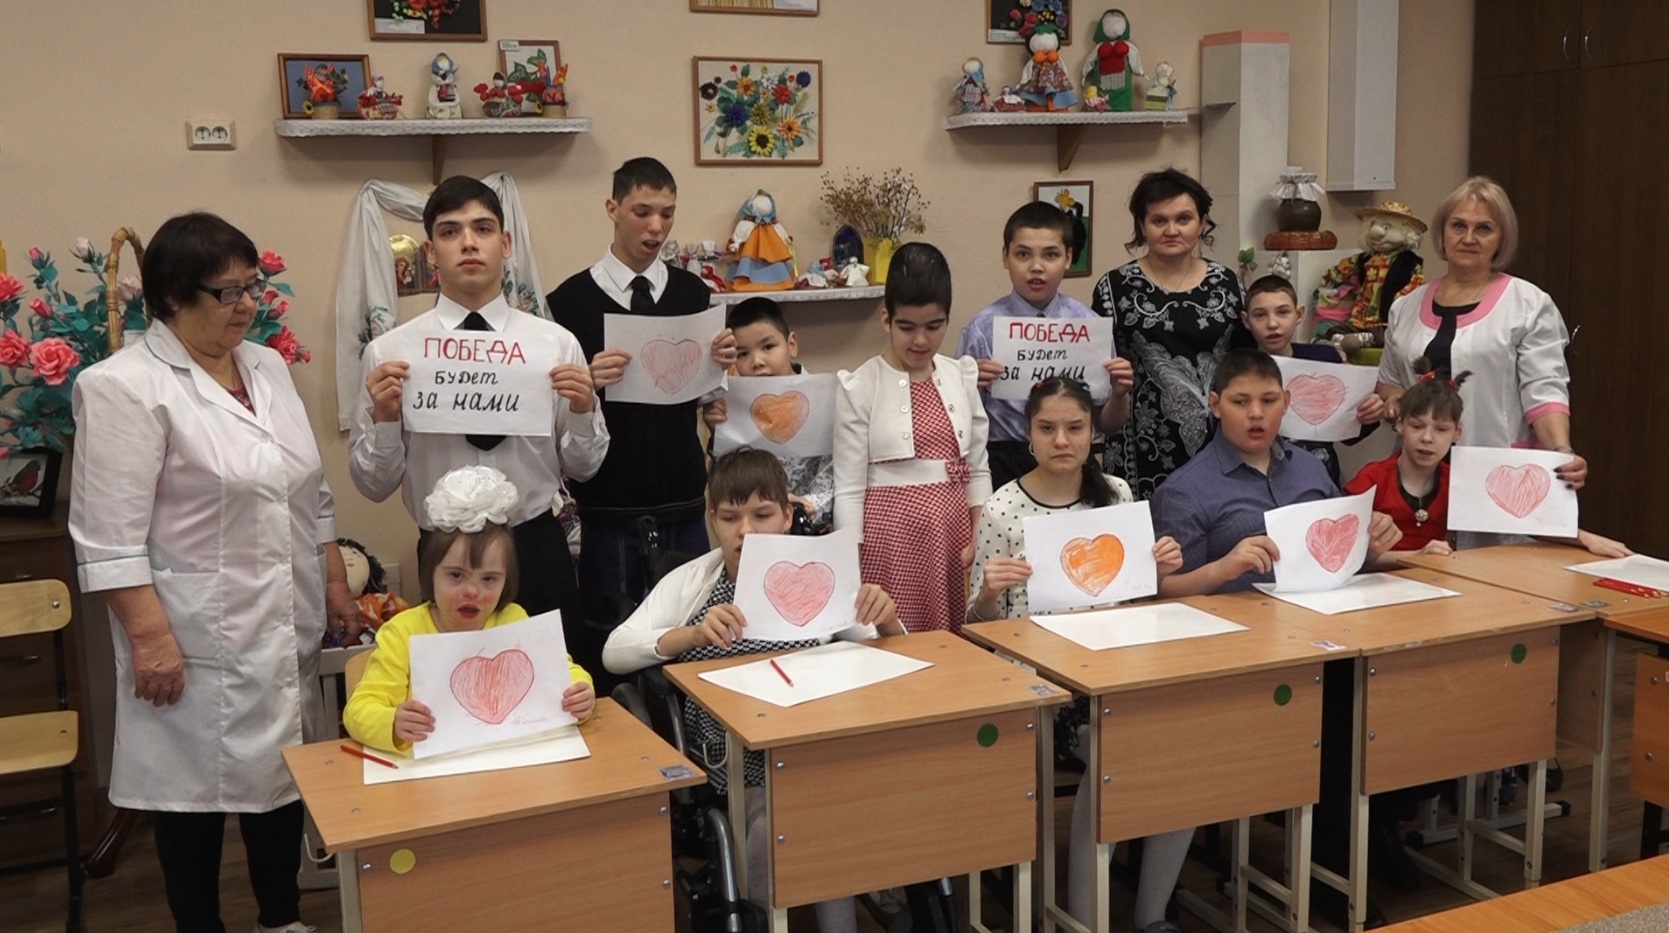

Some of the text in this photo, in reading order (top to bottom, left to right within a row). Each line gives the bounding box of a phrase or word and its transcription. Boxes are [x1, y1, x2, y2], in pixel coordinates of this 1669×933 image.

[1009, 322, 1090, 343] ПОБЕДА
[424, 337, 526, 365] ПОБЕДА
[413, 391, 520, 412] за нами
